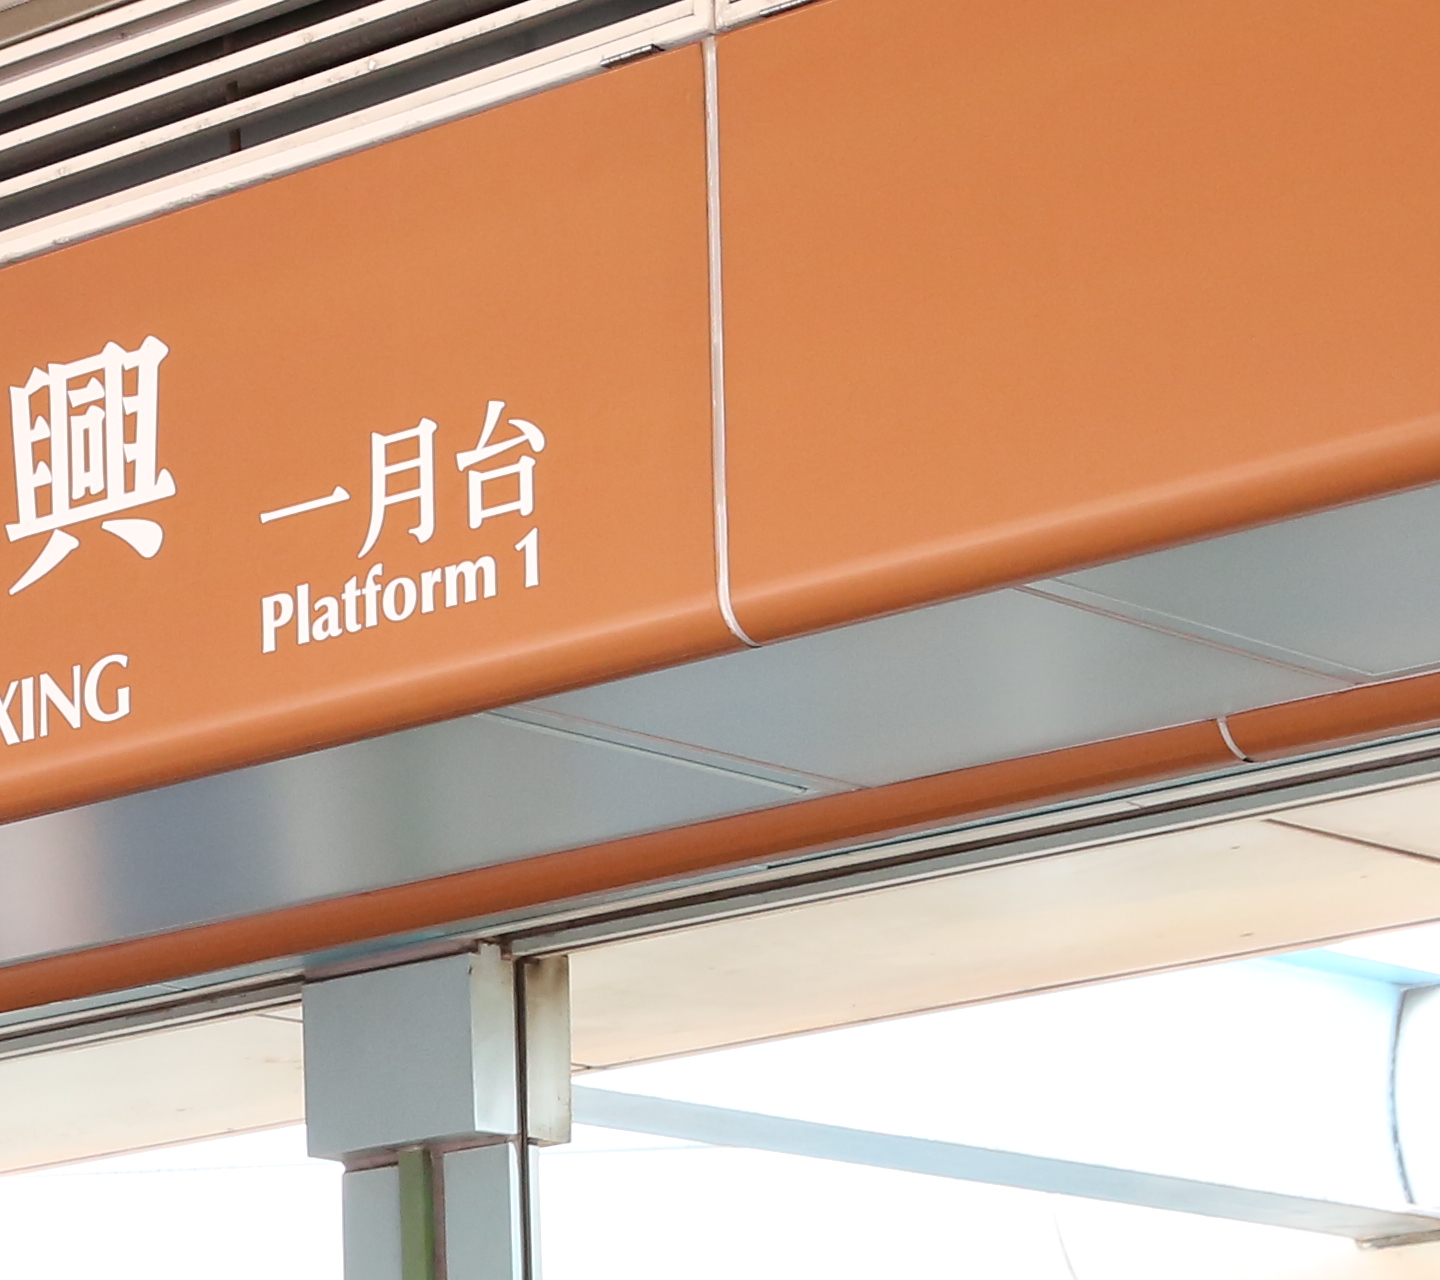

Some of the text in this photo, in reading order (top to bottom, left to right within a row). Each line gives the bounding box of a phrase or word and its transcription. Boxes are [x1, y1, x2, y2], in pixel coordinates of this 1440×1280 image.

[258, 399, 547, 560] 一月台
[260, 527, 542, 655] Platform 1
